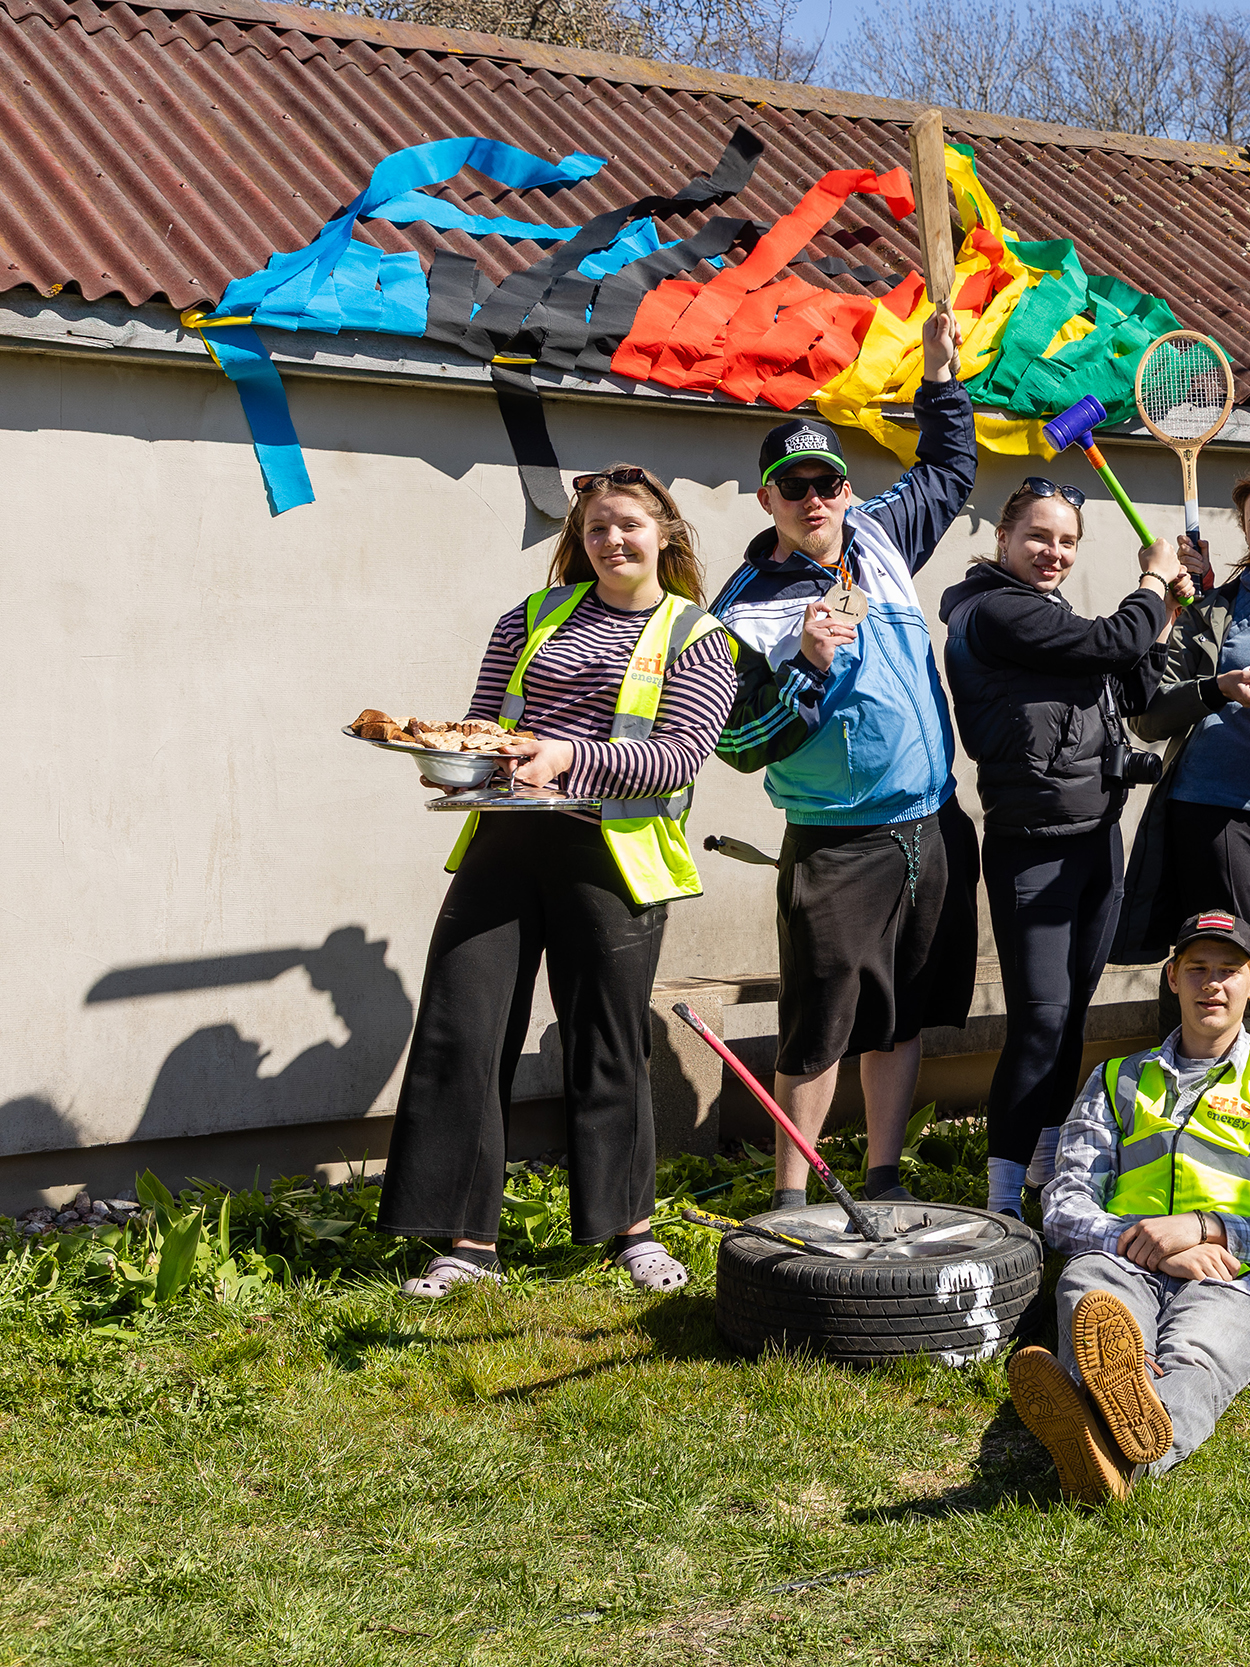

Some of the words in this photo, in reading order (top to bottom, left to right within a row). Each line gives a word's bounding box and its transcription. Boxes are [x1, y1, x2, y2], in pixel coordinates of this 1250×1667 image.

[795, 442, 822, 450] CAMP
[631, 672, 662, 689] energ
[1207, 1110, 1250, 1130] energy
